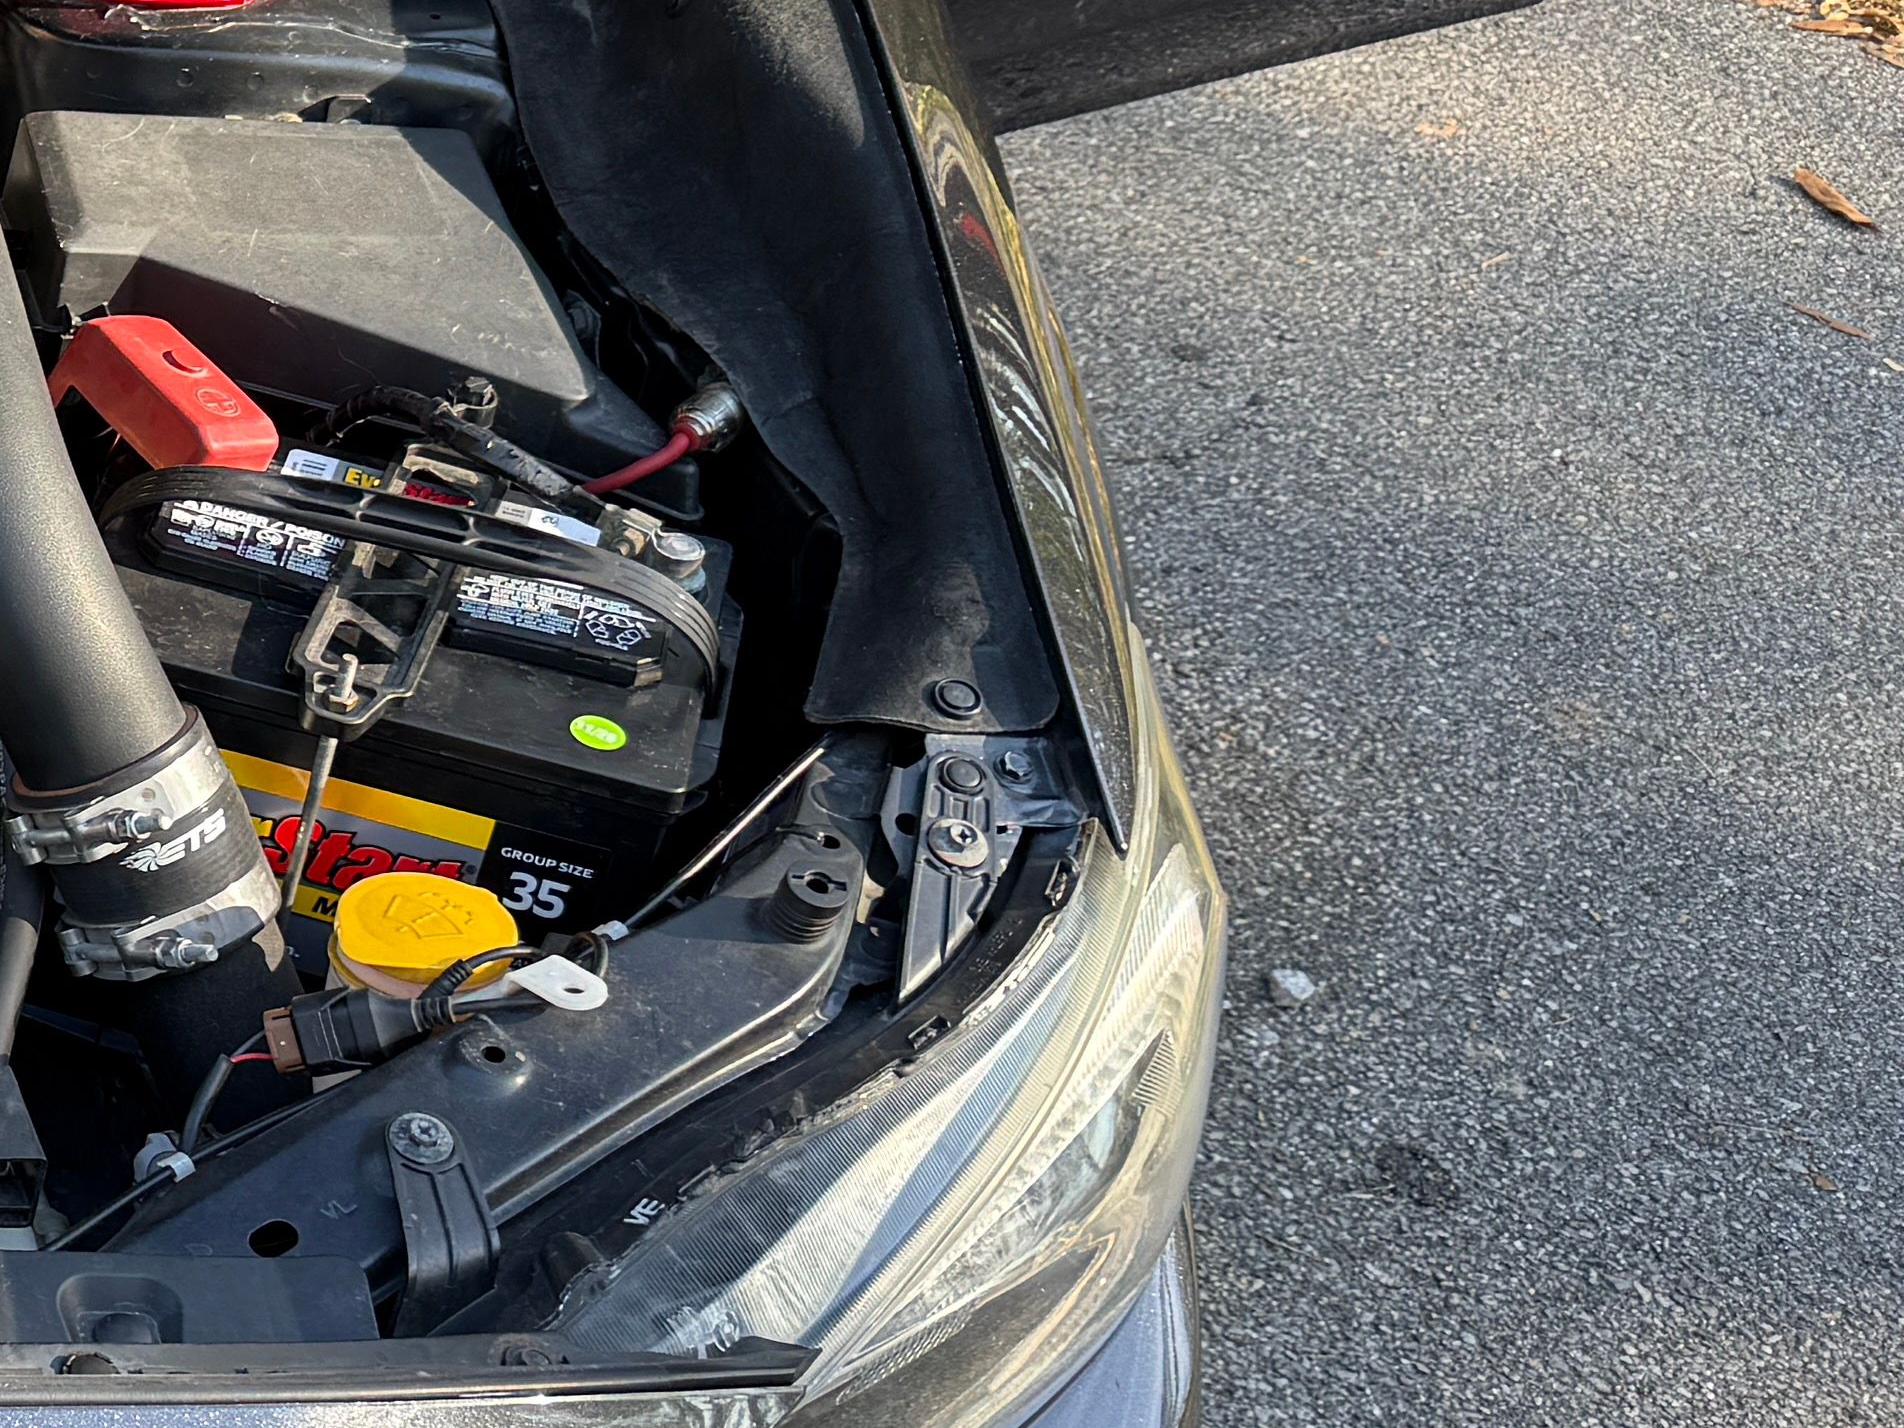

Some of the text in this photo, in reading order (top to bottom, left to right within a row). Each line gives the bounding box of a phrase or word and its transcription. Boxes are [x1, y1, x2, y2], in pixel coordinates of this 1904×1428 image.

[203, 501, 269, 527] DANGER
[284, 523, 346, 548] POISON
[154, 807, 227, 867] ETS
[500, 846, 595, 880] GROUP SIZE
[501, 871, 572, 920] 35
